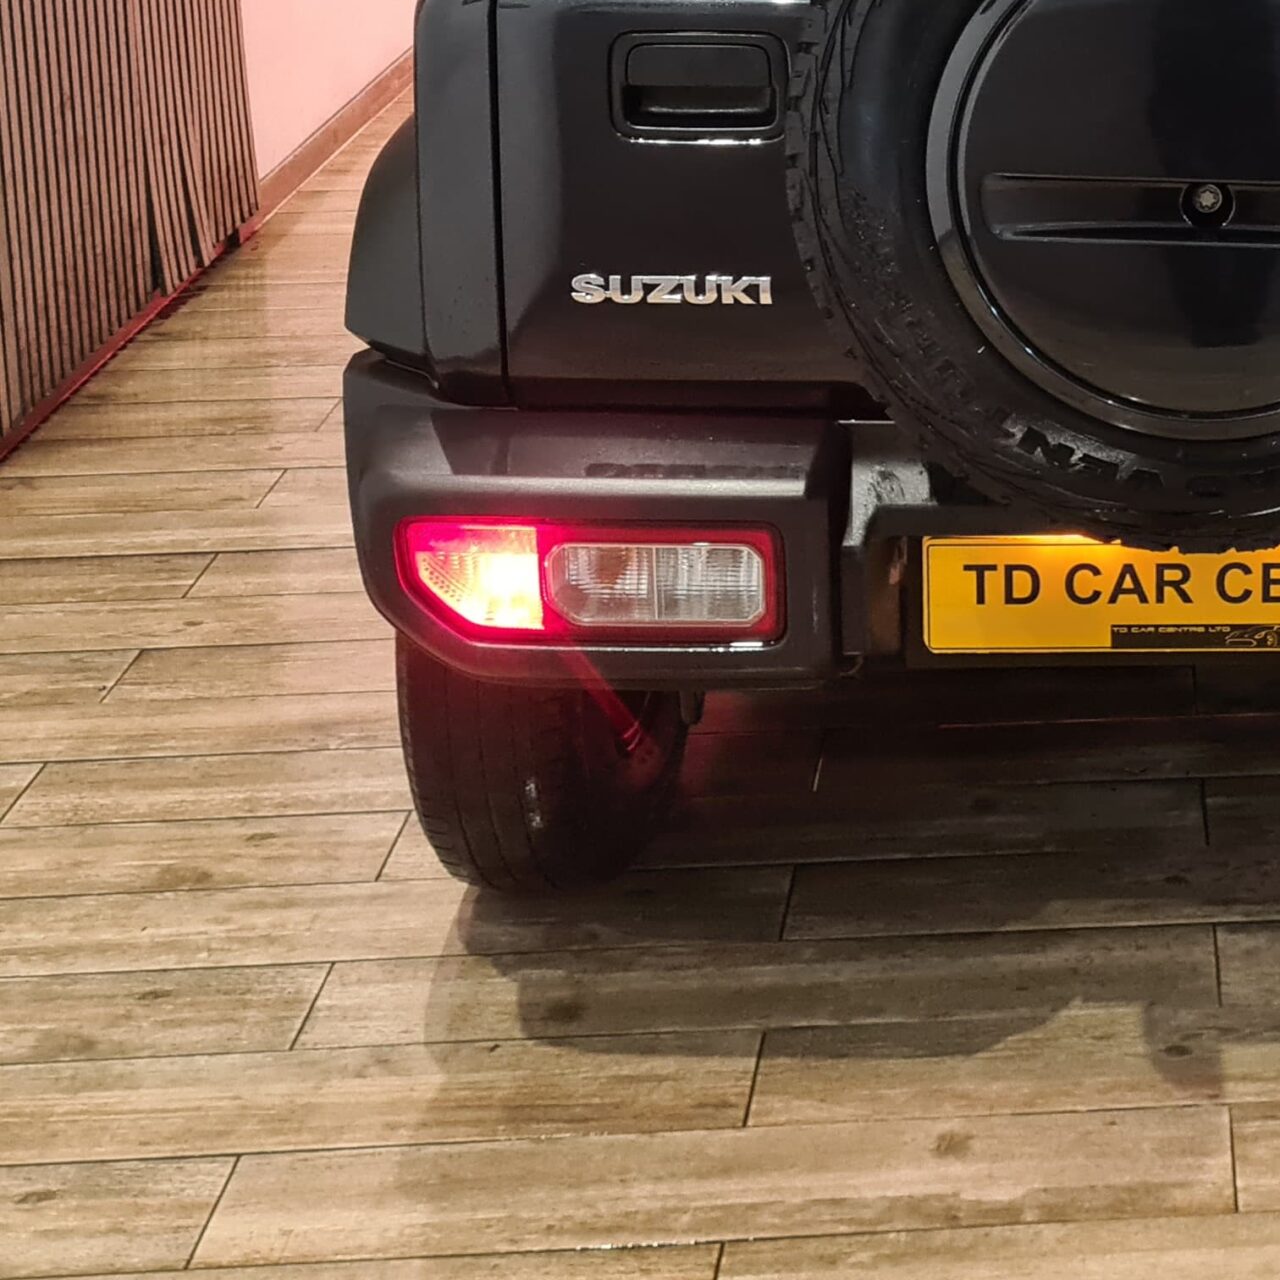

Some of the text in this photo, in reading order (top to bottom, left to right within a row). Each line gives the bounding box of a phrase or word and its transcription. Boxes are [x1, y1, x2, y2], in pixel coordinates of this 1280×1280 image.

[571, 273, 772, 305] SUZUKI
[963, 563, 1041, 605] TD
[1064, 562, 1193, 606] CAR
[1208, 625, 1231, 633] LTD
